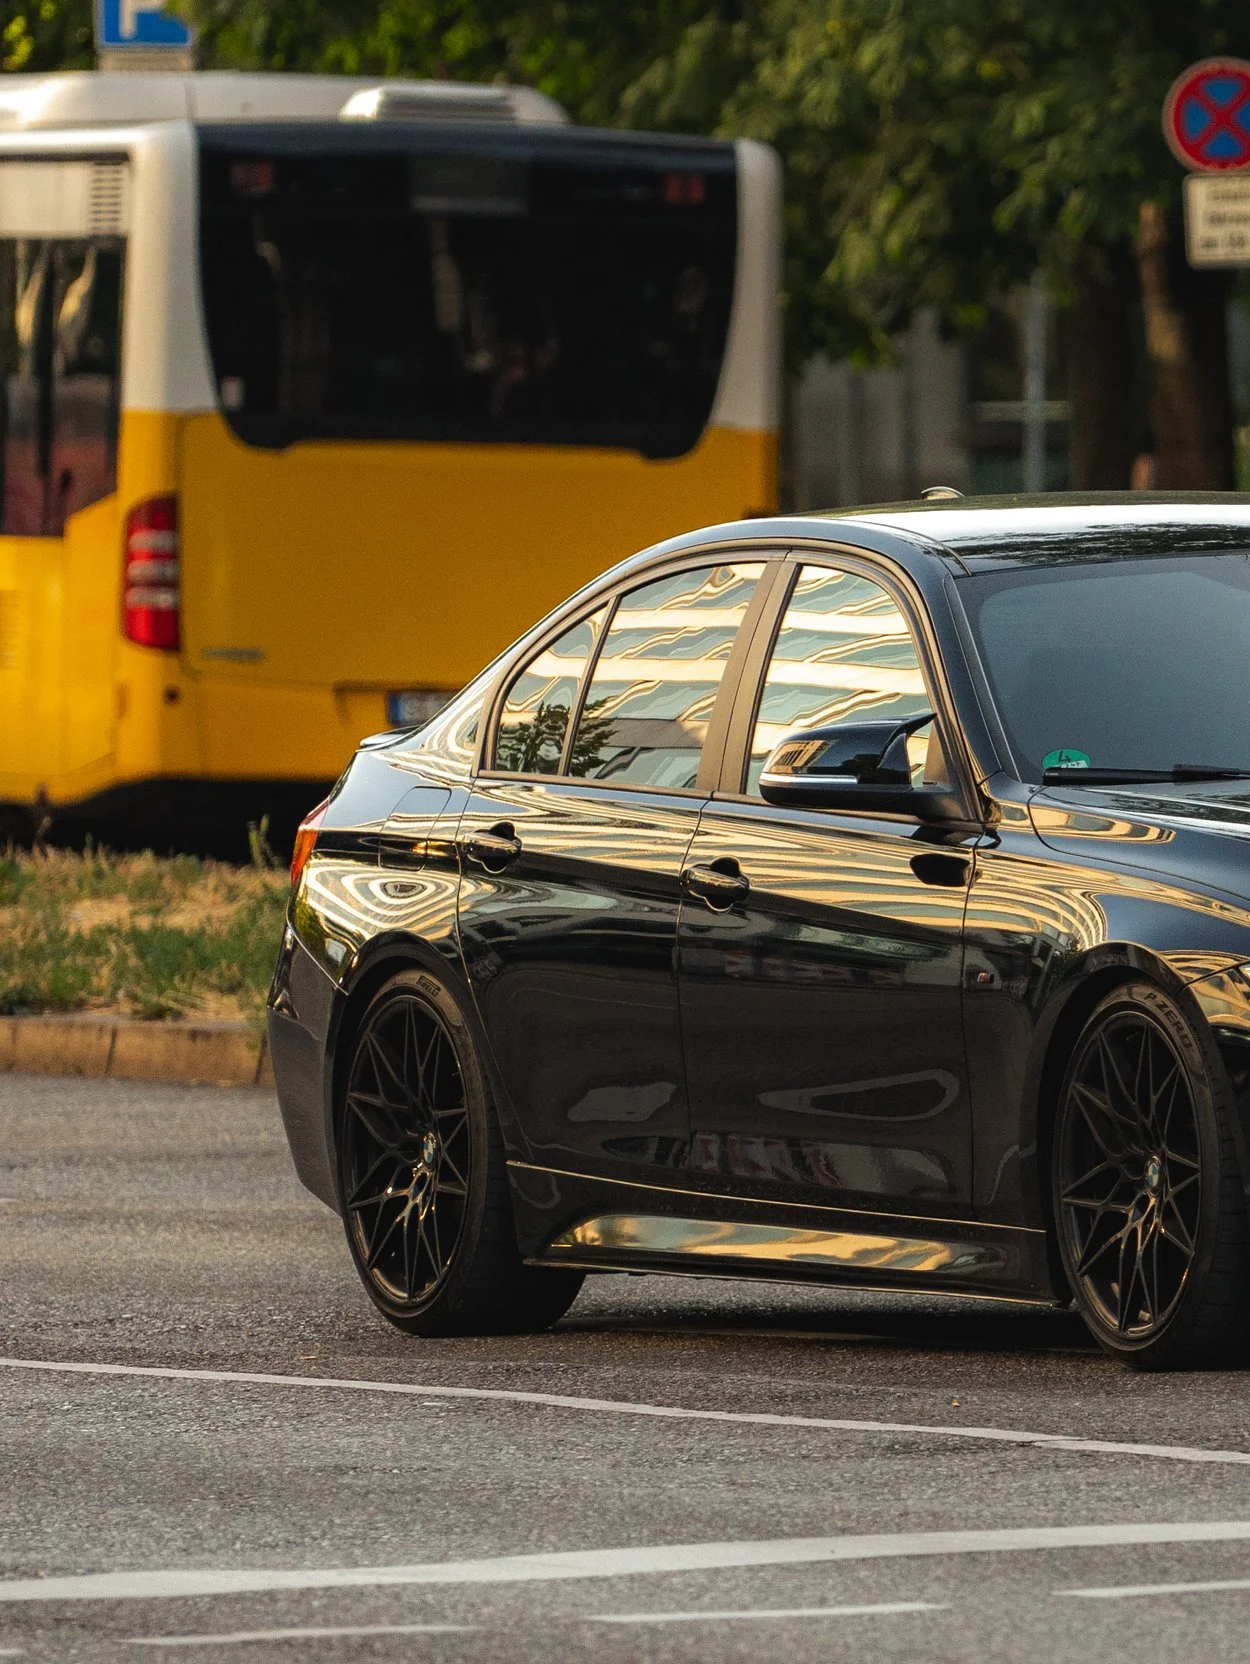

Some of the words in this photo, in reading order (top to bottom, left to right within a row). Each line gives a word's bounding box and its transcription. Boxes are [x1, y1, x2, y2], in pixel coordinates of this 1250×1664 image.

[417, 975, 441, 997] PIRELLI
[1144, 992, 1157, 1001] P
[1156, 1000, 1193, 1049] ZERO
